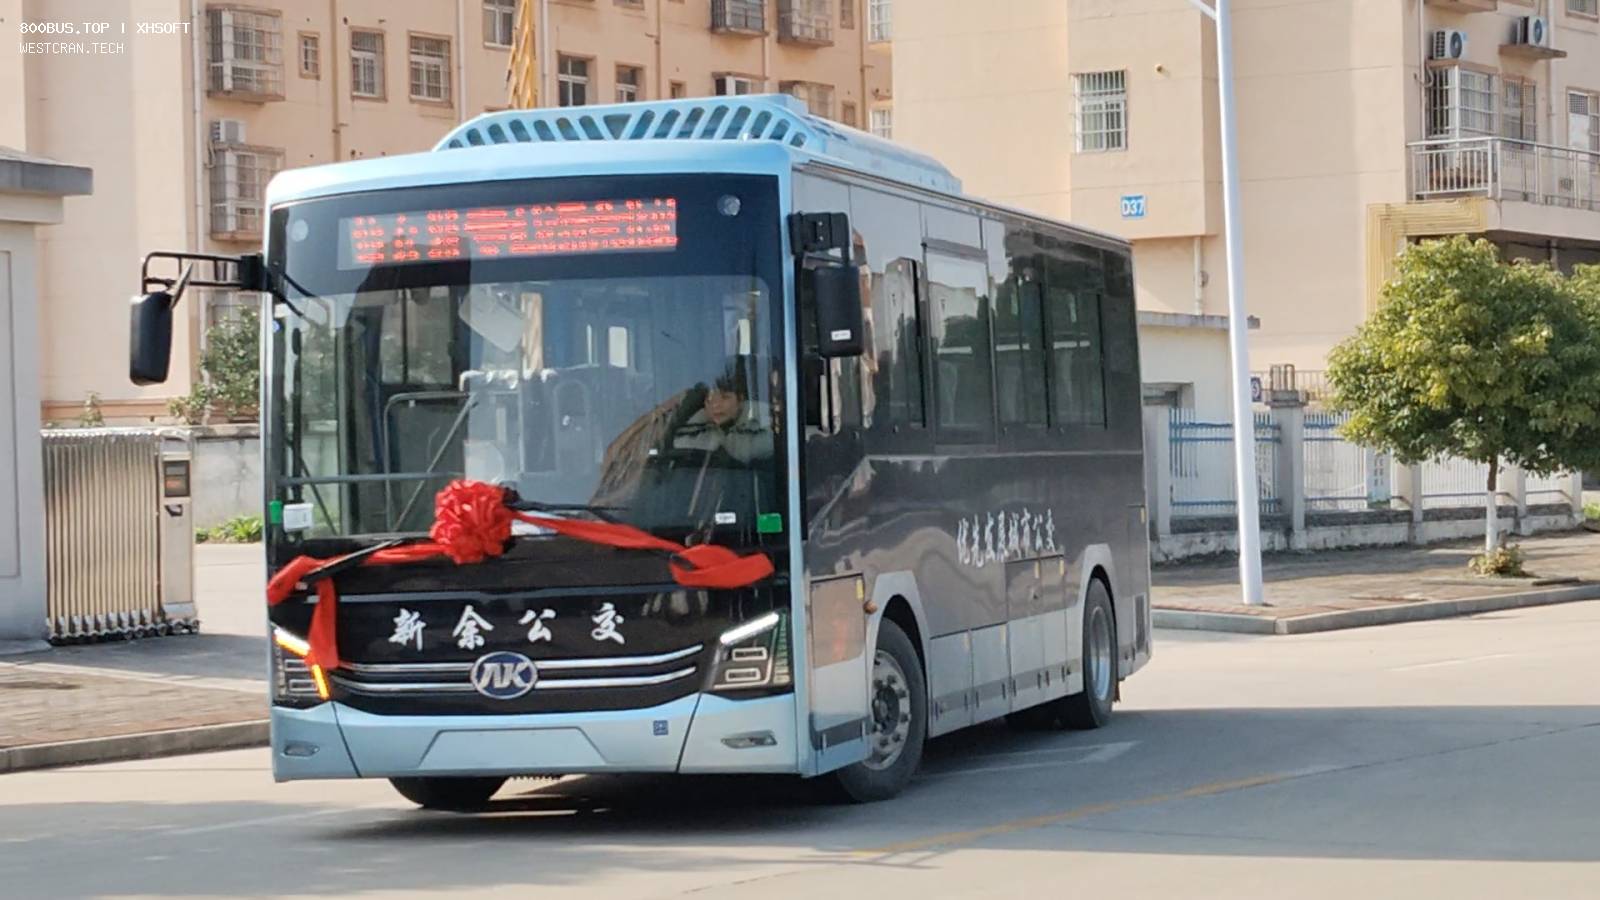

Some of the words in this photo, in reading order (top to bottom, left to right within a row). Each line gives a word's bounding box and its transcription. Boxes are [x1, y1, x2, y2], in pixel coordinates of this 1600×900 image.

[1121, 199, 1144, 215] D37
[388, 602, 625, 651] 新余公交
